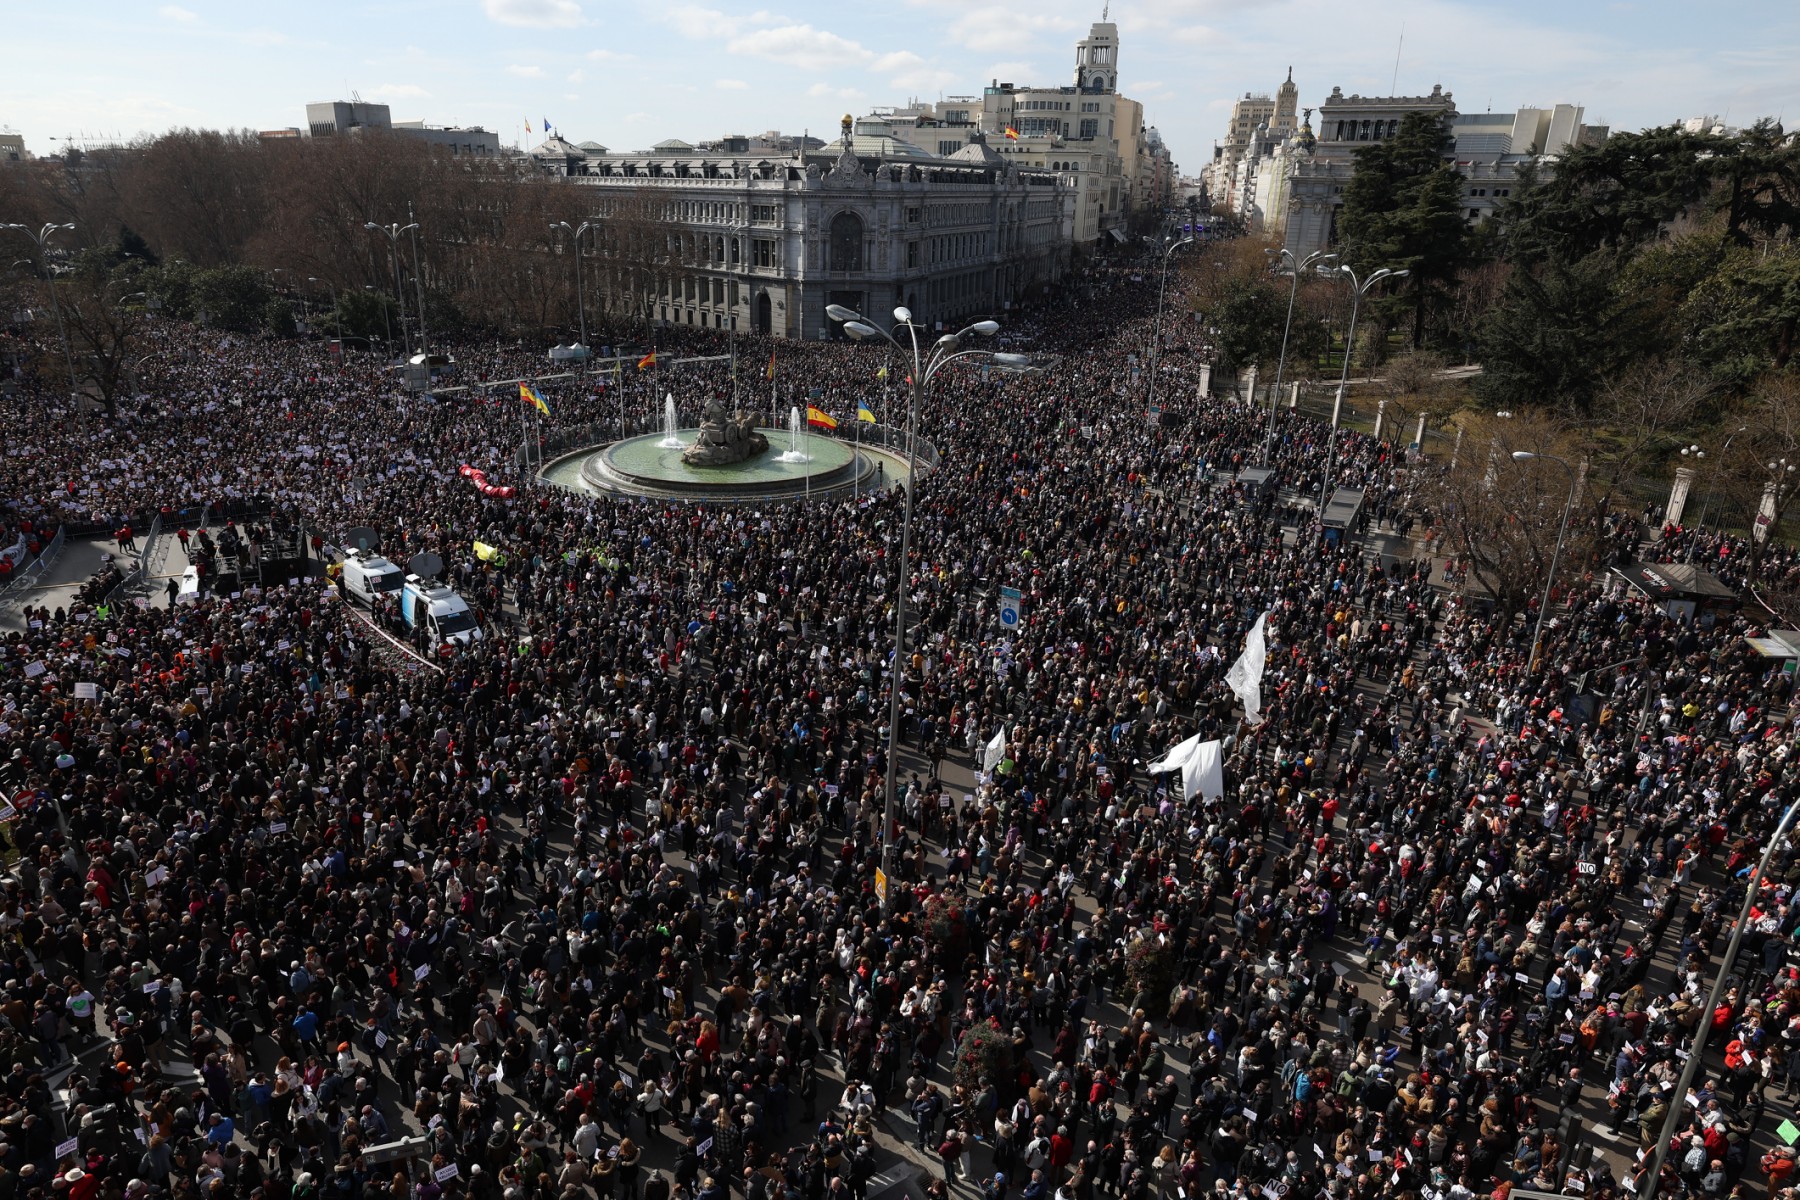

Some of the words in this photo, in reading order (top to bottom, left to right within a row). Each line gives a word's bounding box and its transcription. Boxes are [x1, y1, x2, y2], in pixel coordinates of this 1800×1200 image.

[1580, 863, 1595, 874] NO
[1266, 1179, 1288, 1194] NO
[1421, 1185, 1435, 1200] NO
